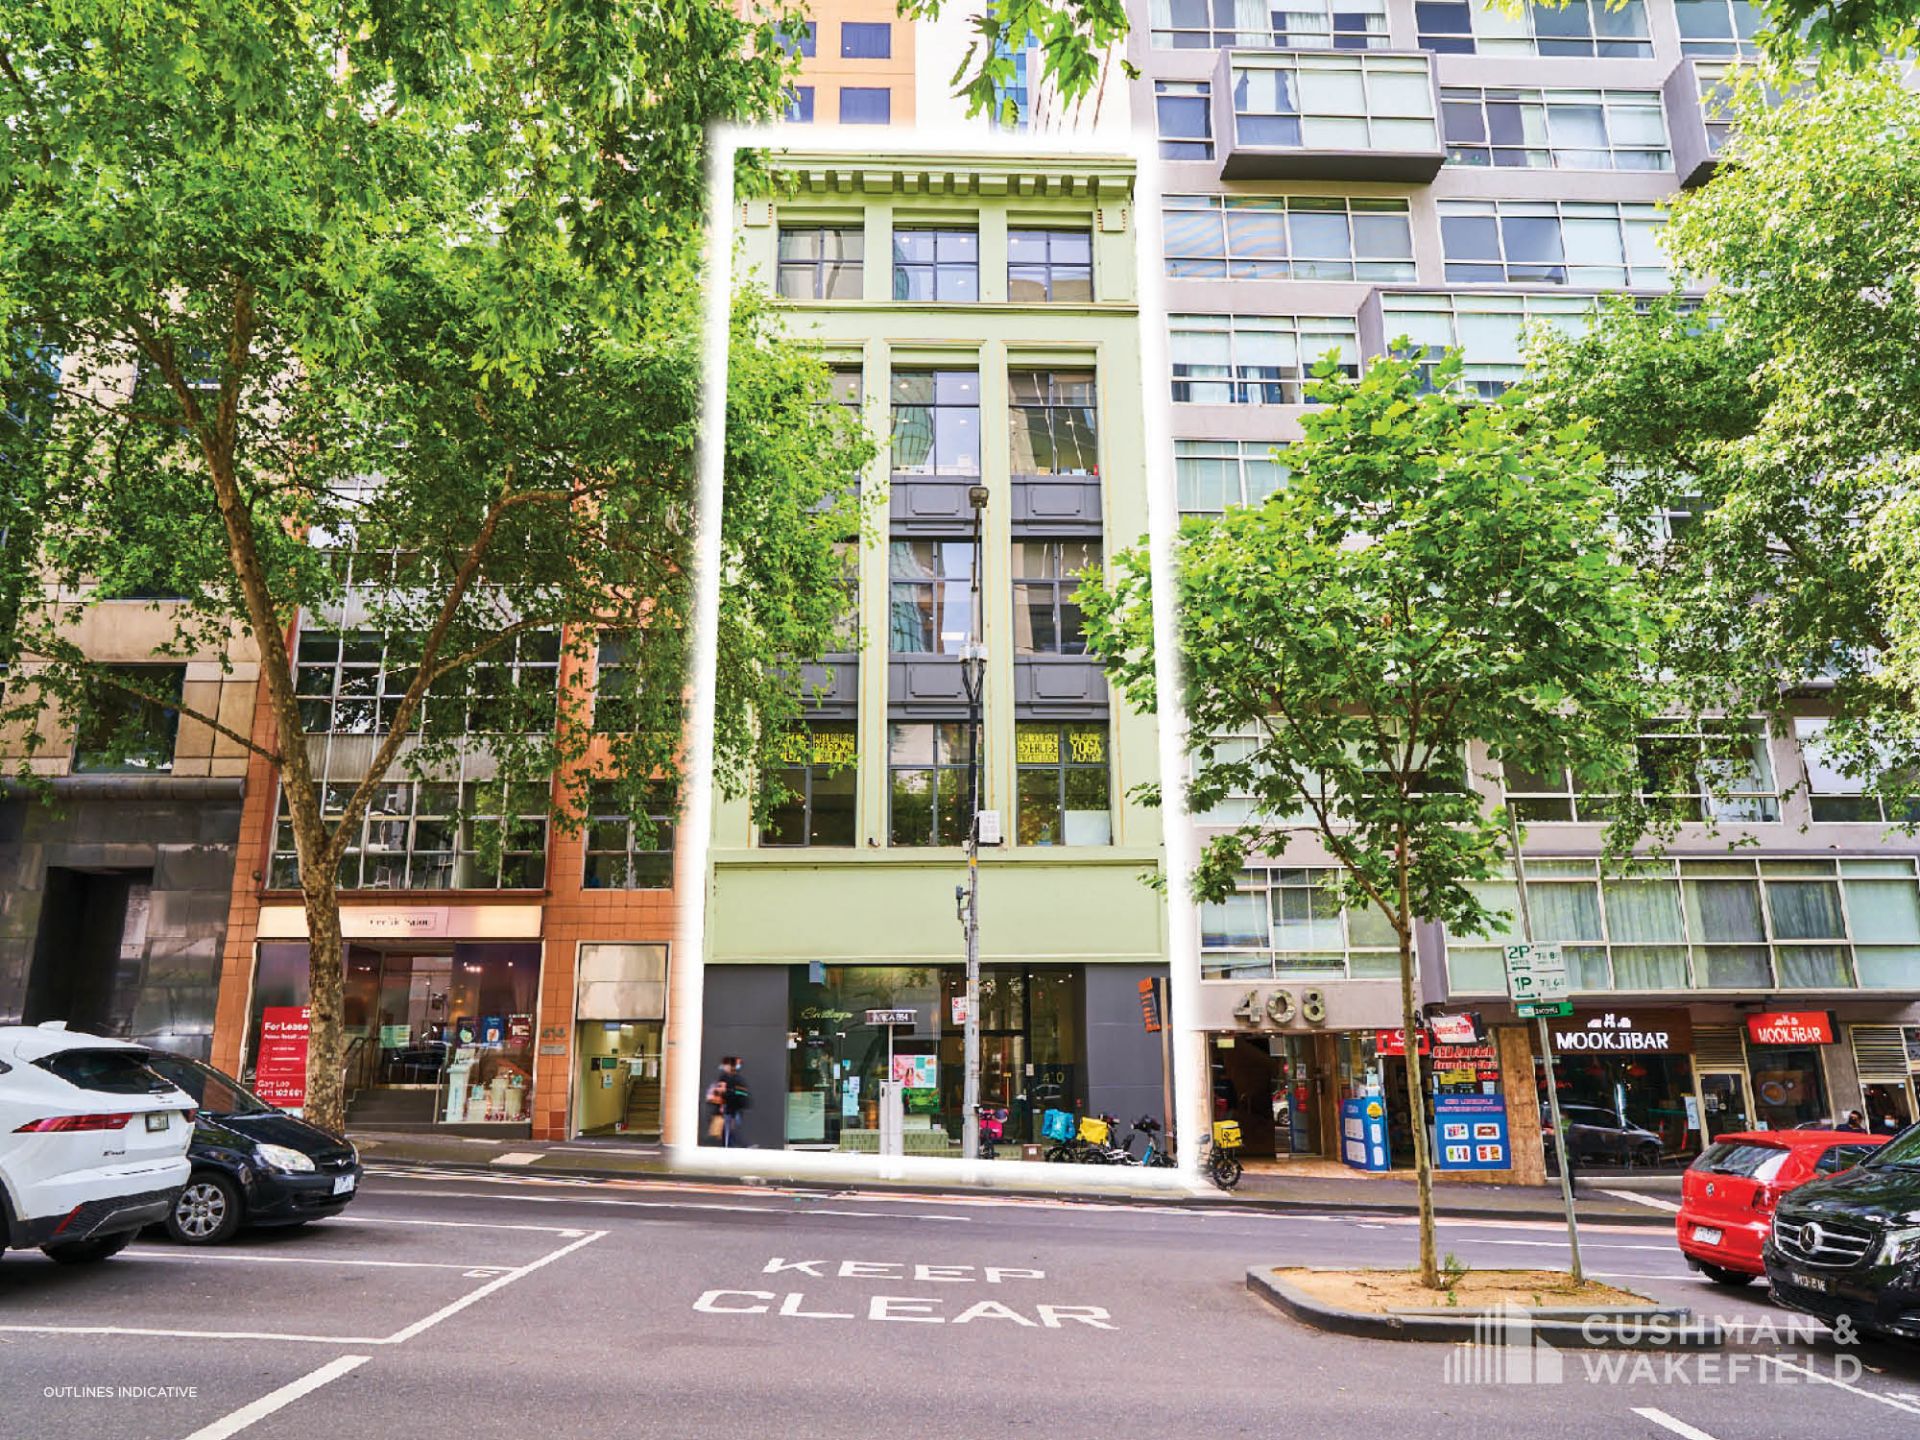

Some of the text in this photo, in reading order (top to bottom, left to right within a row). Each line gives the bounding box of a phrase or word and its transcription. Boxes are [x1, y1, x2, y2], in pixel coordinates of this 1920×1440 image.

[1507, 945, 1530, 959] 2P
[1514, 976, 1532, 991] 1P
[1232, 987, 1325, 1023] 408
[264, 1022, 309, 1031] For Lease
[1555, 1031, 1670, 1050] MOOKJIBAR
[762, 1257, 1046, 1283] KEEP
[692, 1289, 1120, 1330] CLEAR
